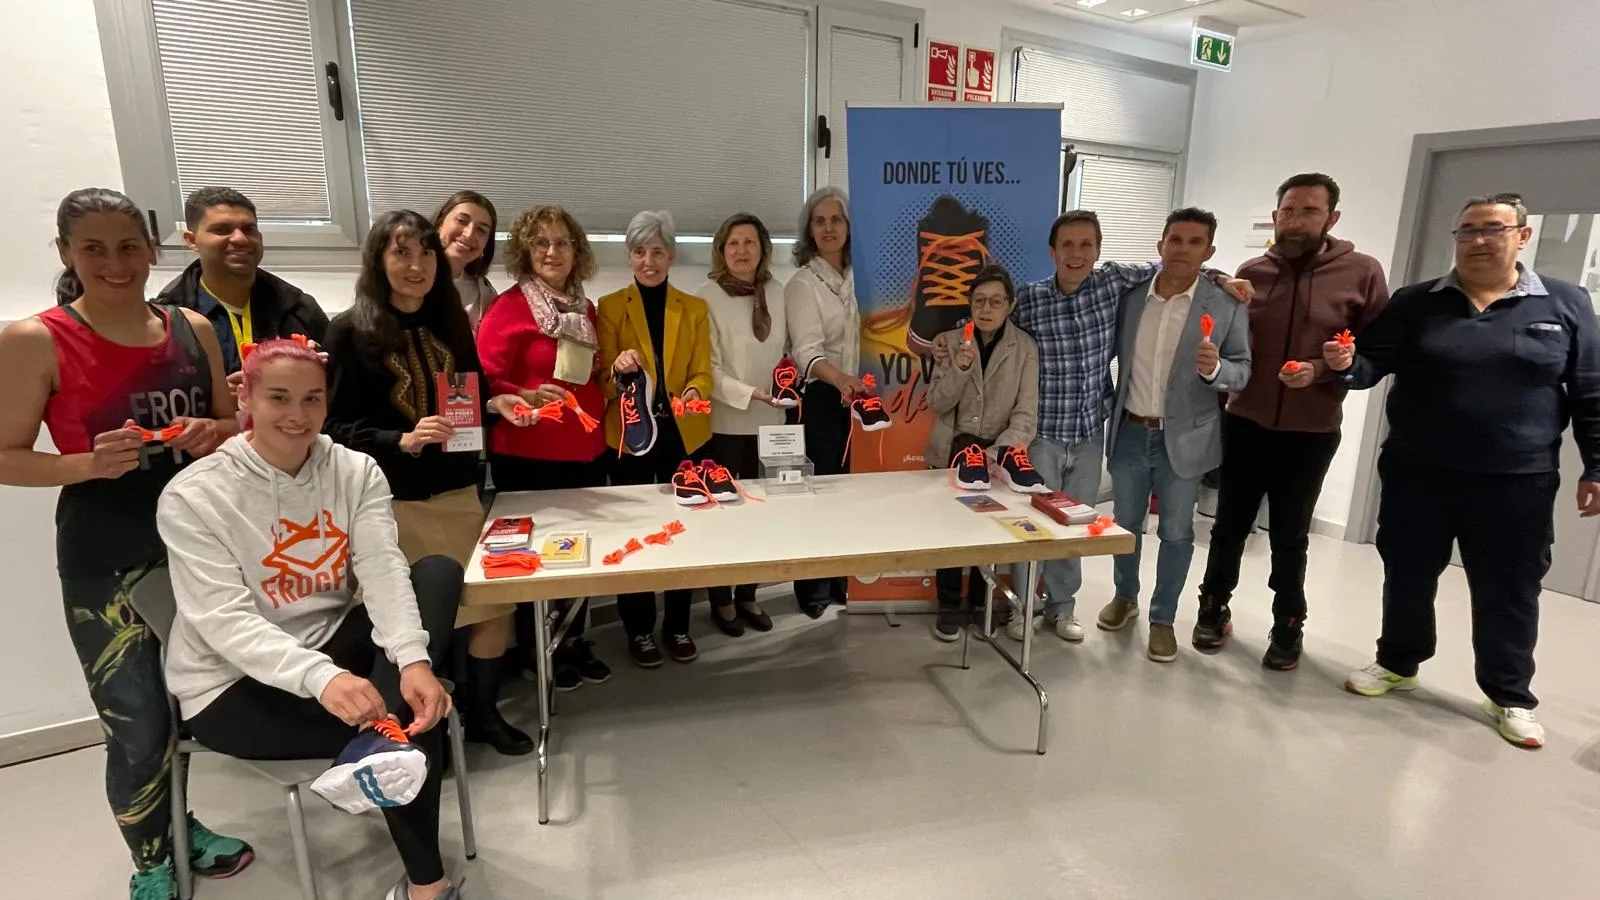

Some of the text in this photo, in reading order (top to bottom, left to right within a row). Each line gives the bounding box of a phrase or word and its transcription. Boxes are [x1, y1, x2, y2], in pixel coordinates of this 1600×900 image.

[883, 156, 1021, 185] DONDE TÚ VES...
[880, 352, 936, 385] YO V
[129, 386, 206, 426] FROG
[260, 563, 346, 609] FROGF
